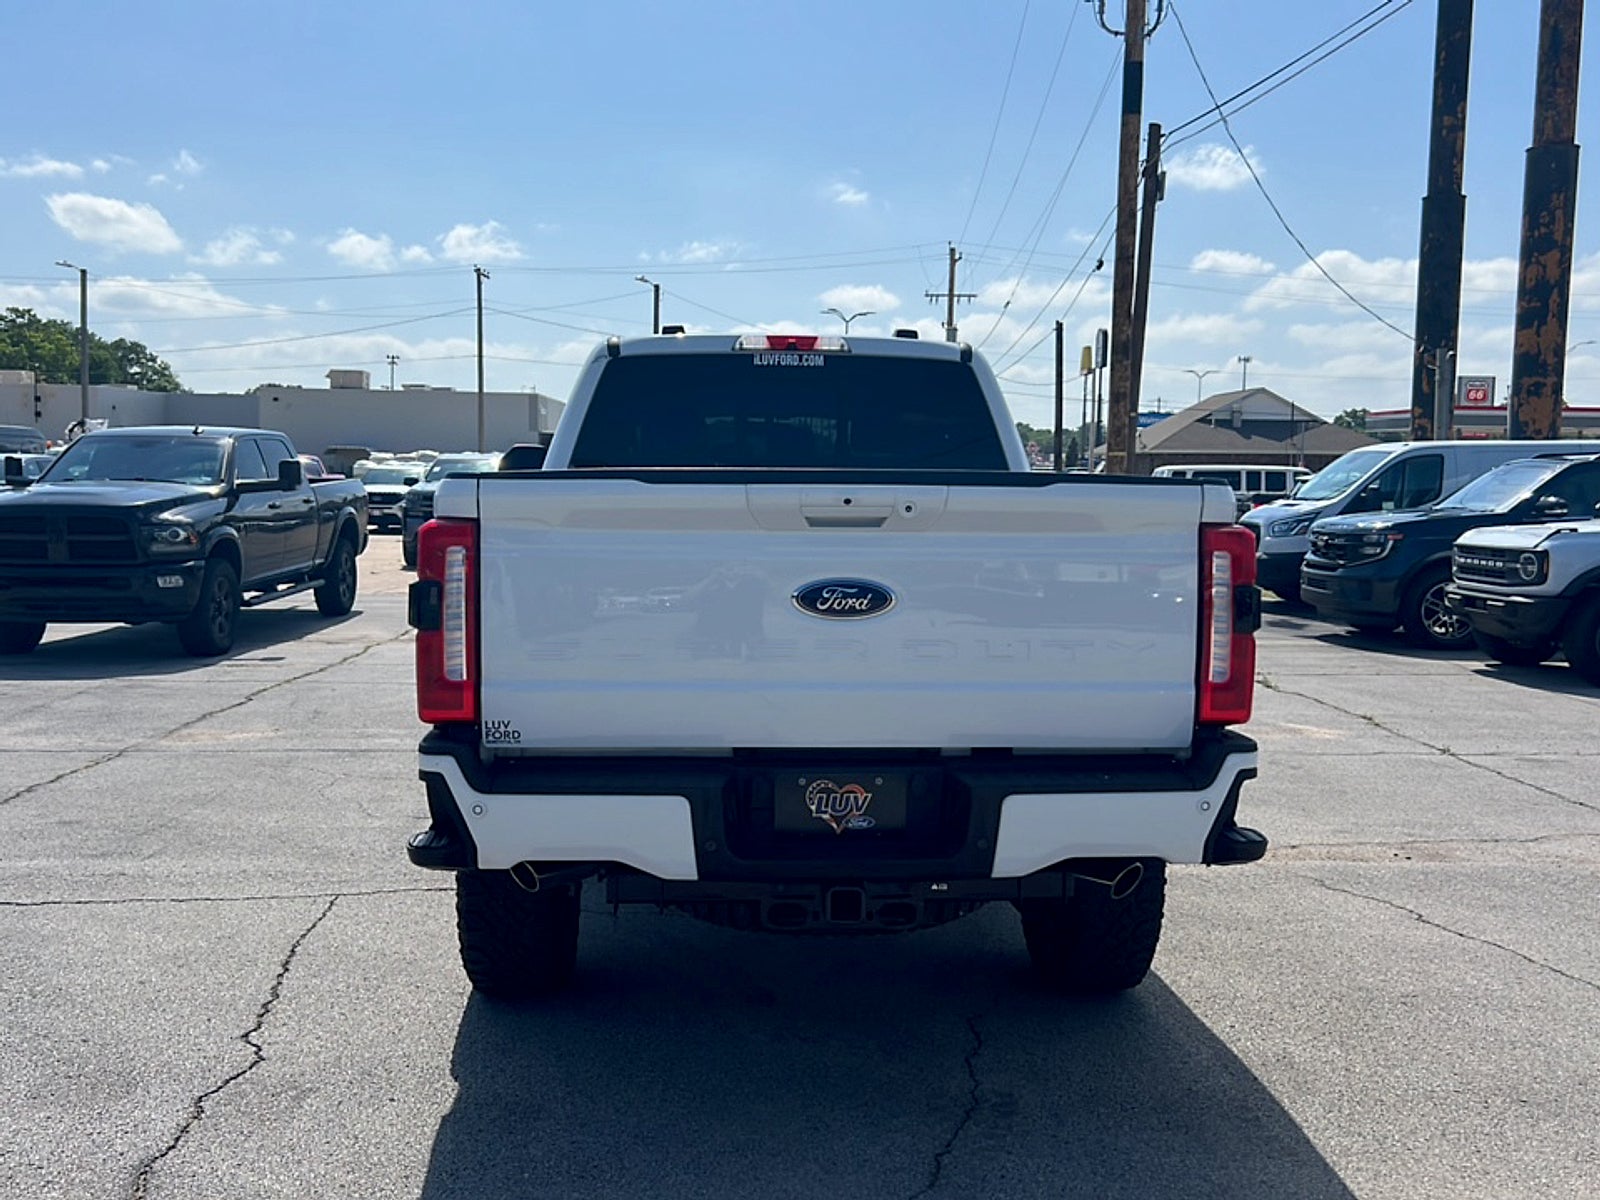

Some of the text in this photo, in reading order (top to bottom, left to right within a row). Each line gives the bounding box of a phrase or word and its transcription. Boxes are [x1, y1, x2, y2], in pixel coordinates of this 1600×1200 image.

[1468, 389, 1485, 400] 66
[816, 586, 872, 610] Ford
[484, 719, 511, 729] LUV
[485, 729, 521, 740] FORD
[814, 793, 872, 815] LUV
